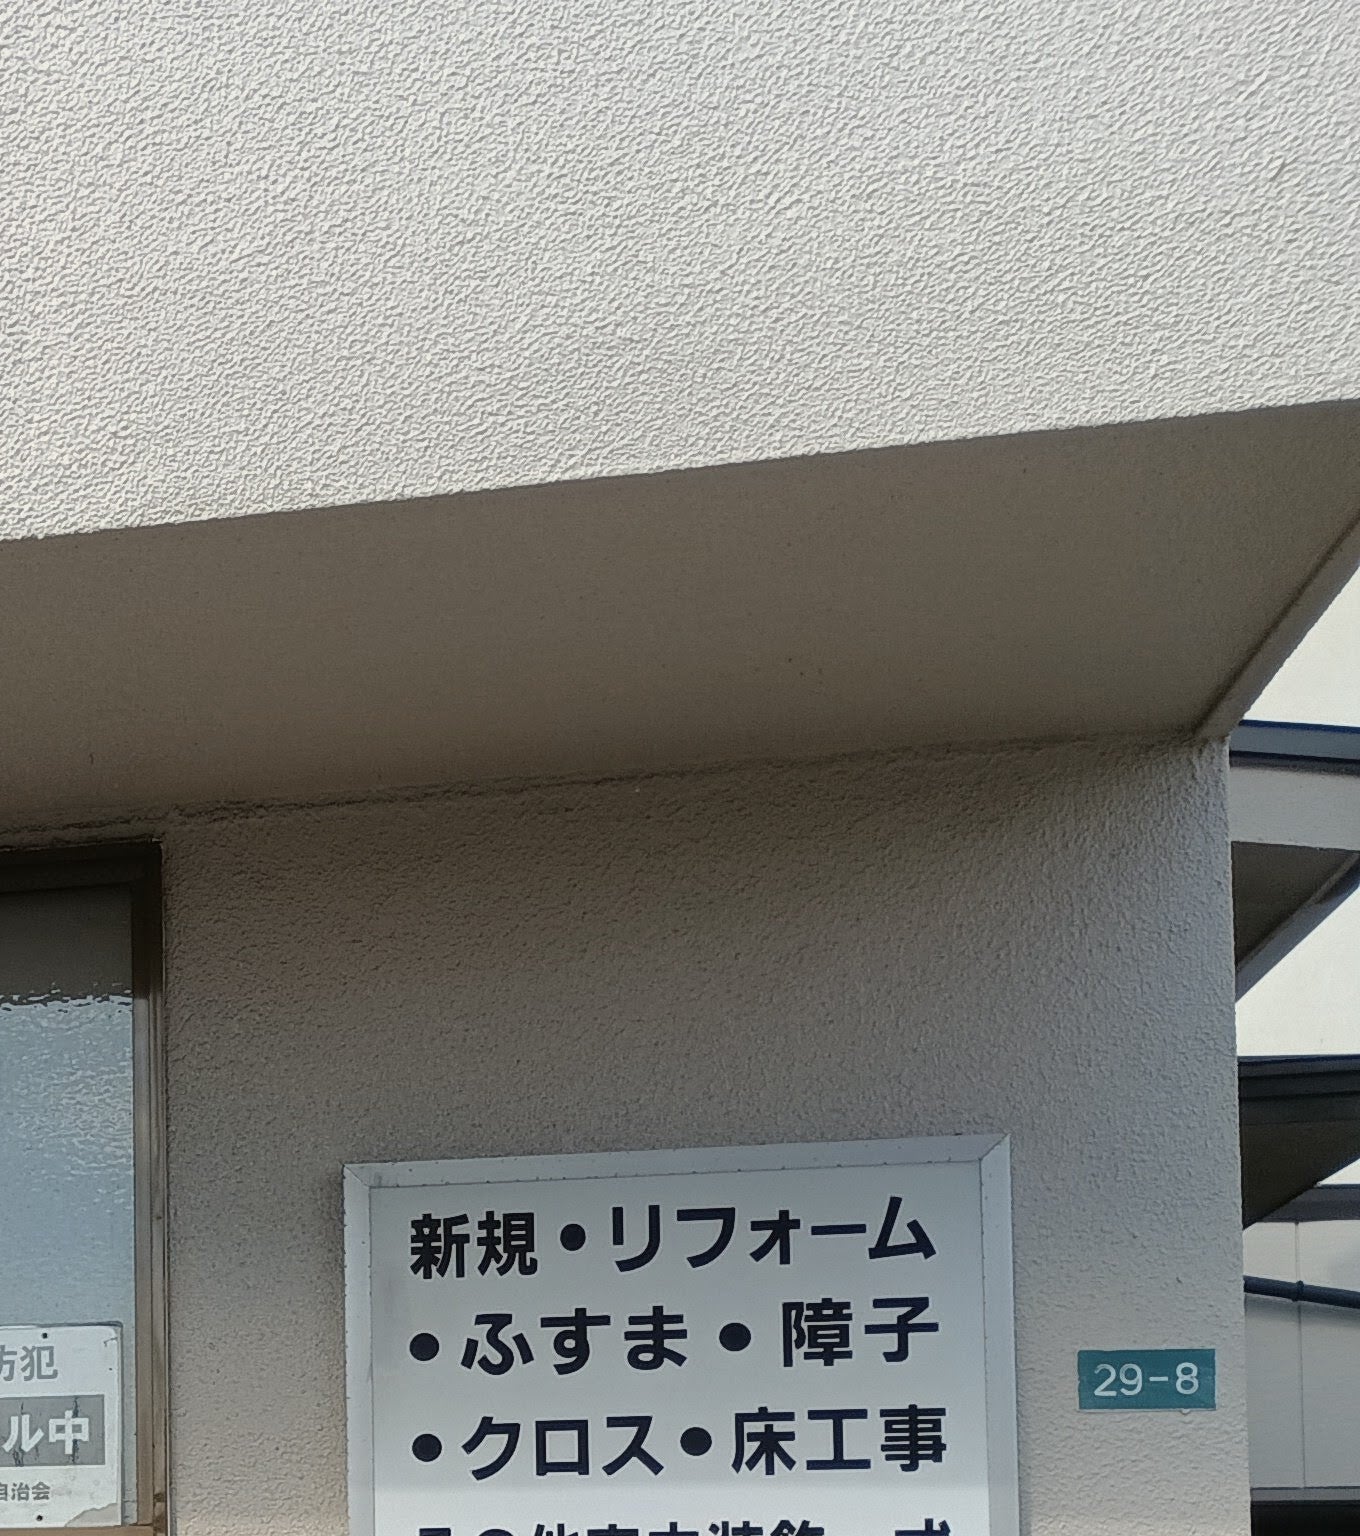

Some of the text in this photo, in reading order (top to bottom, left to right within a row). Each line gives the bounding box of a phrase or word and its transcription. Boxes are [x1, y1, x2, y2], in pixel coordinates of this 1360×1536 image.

[410, 1196, 937, 1280] 新規・リフォーム
[1093, 1361, 1199, 1397] 29-8
